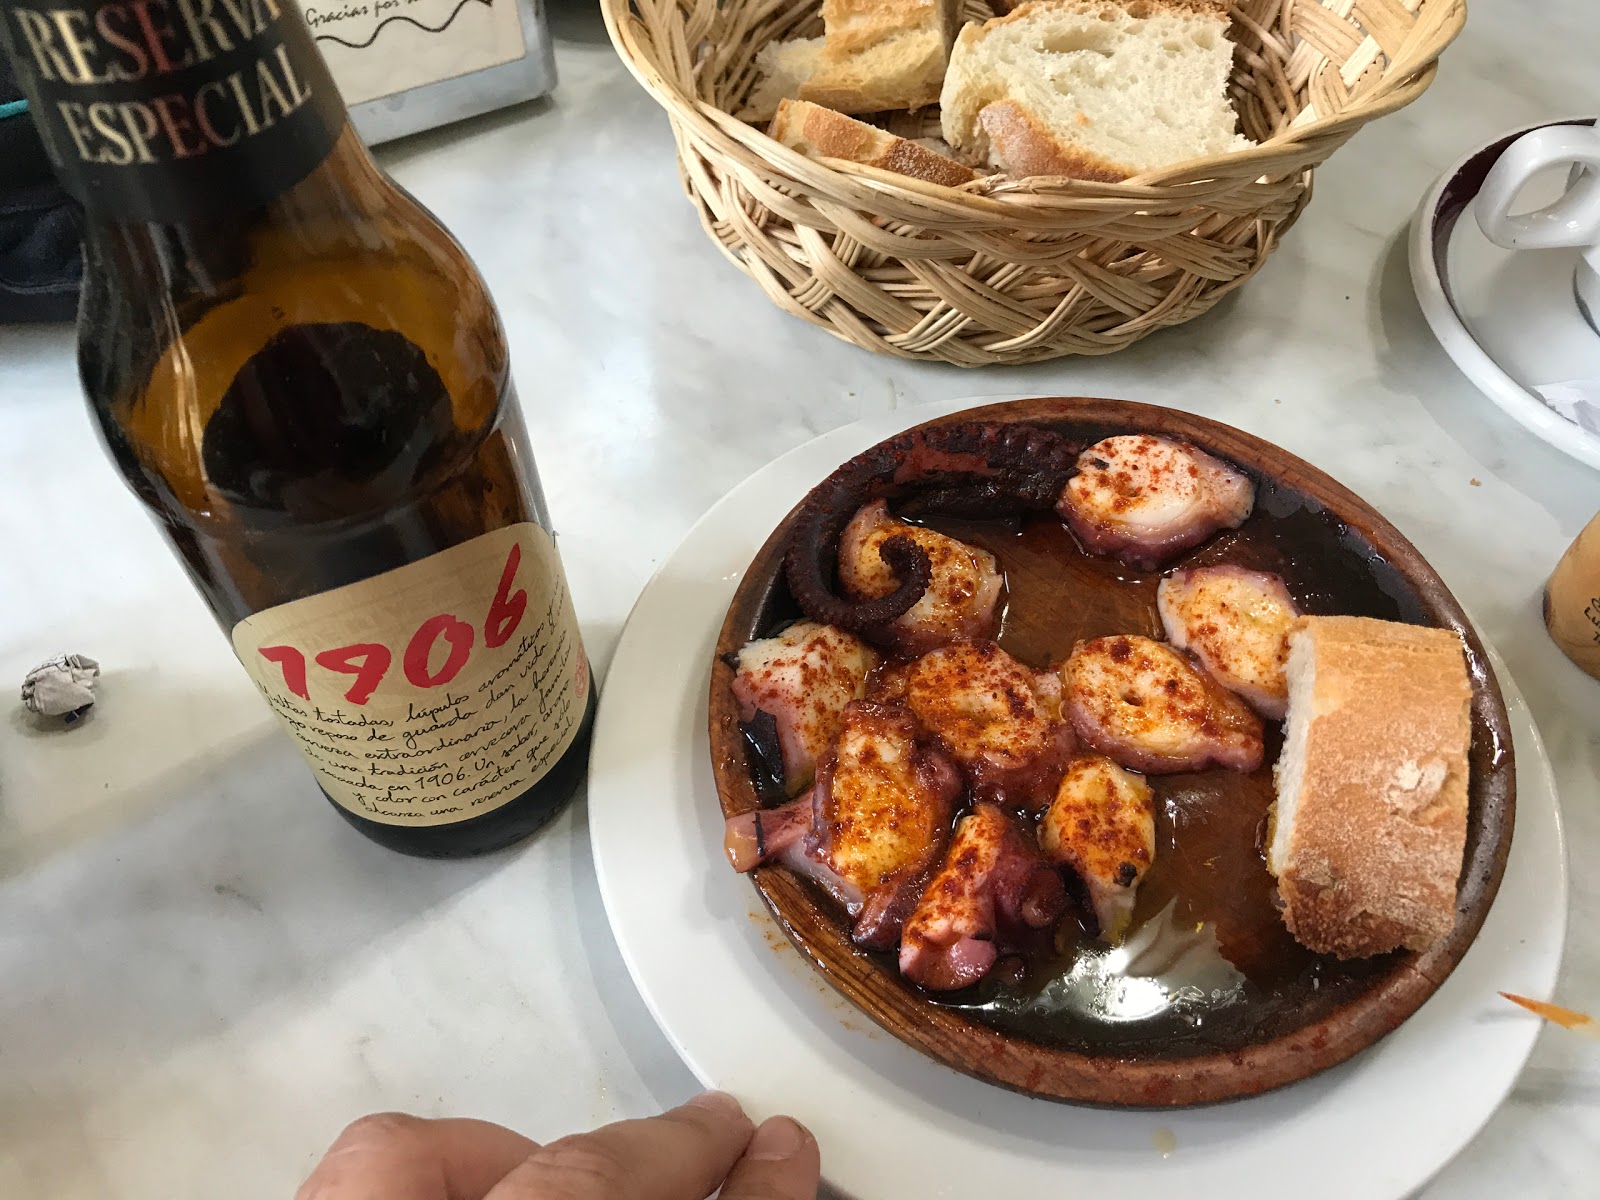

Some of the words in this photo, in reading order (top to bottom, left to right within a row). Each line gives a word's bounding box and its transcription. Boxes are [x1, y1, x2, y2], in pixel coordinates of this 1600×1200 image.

[305, 7, 369, 28] Gracias
[57, 42, 312, 165] ESPECIAL
[258, 543, 527, 705] 1906
[309, 726, 358, 742] reposo
[367, 728, 395, 742] de
[402, 708, 478, 749] guarda
[486, 684, 515, 709] dan
[520, 642, 548, 678] vida
[313, 707, 394, 727] tostadas,
[406, 693, 469, 723] lúpulos
[478, 622, 545, 693] aromáticos
[328, 760, 363, 773] una
[368, 762, 448, 776] tradición
[459, 713, 532, 762] cervecera
[365, 715, 508, 760] extraordinaria,
[510, 694, 529, 714] la
[388, 784, 411, 792] en
[415, 766, 471, 790] 1906.
[474, 757, 495, 772] Un
[501, 722, 538, 758] sabor,
[352, 791, 367, 806] y
[375, 790, 417, 804] color
[421, 795, 447, 803] con
[453, 759, 521, 796] carácter
[526, 735, 549, 763] que
[430, 806, 463, 817] una
[470, 777, 527, 807] reserva
